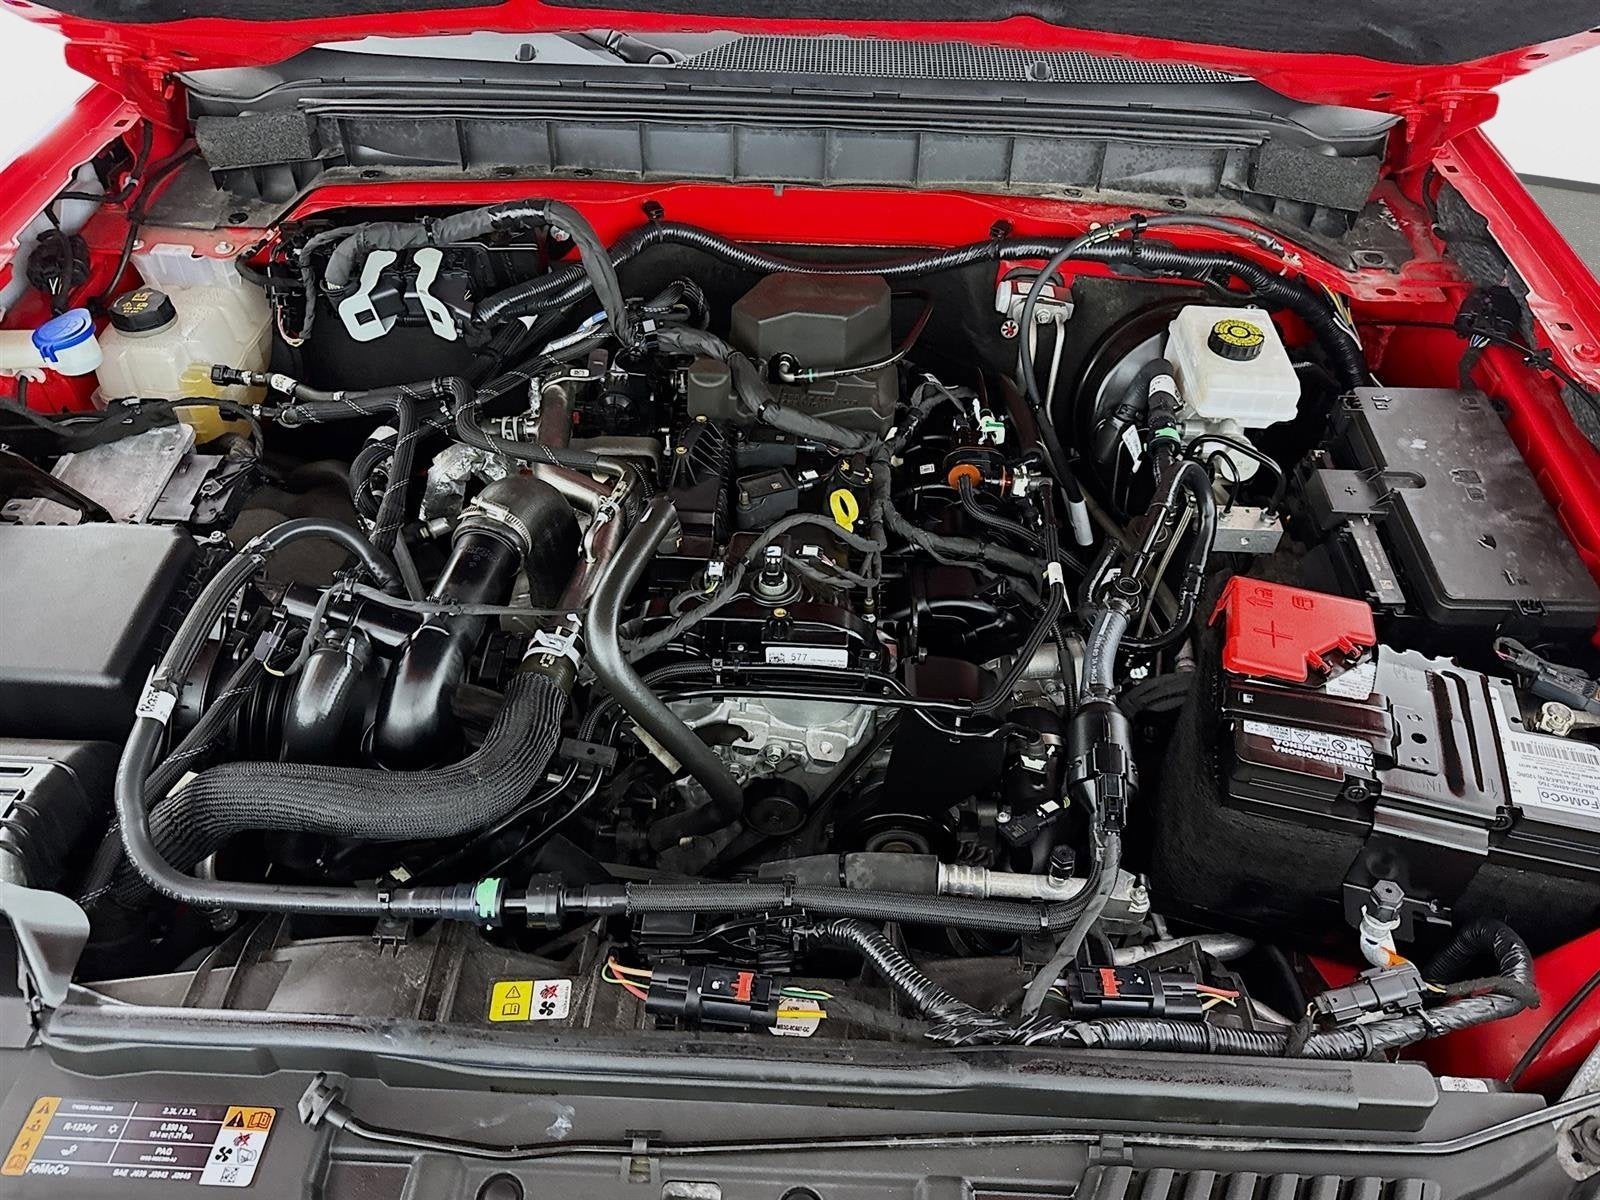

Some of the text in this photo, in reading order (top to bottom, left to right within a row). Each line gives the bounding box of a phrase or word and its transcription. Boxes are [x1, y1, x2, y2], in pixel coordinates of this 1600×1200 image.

[791, 652, 808, 661] 577
[1280, 746, 1365, 770] DANGER/POISON
[1282, 740, 1373, 765] PELIGRO/VENENO
[1541, 791, 1599, 809] FoMoCo
[154, 1147, 174, 1156] PAG
[25, 1163, 70, 1175] FoMoCo
